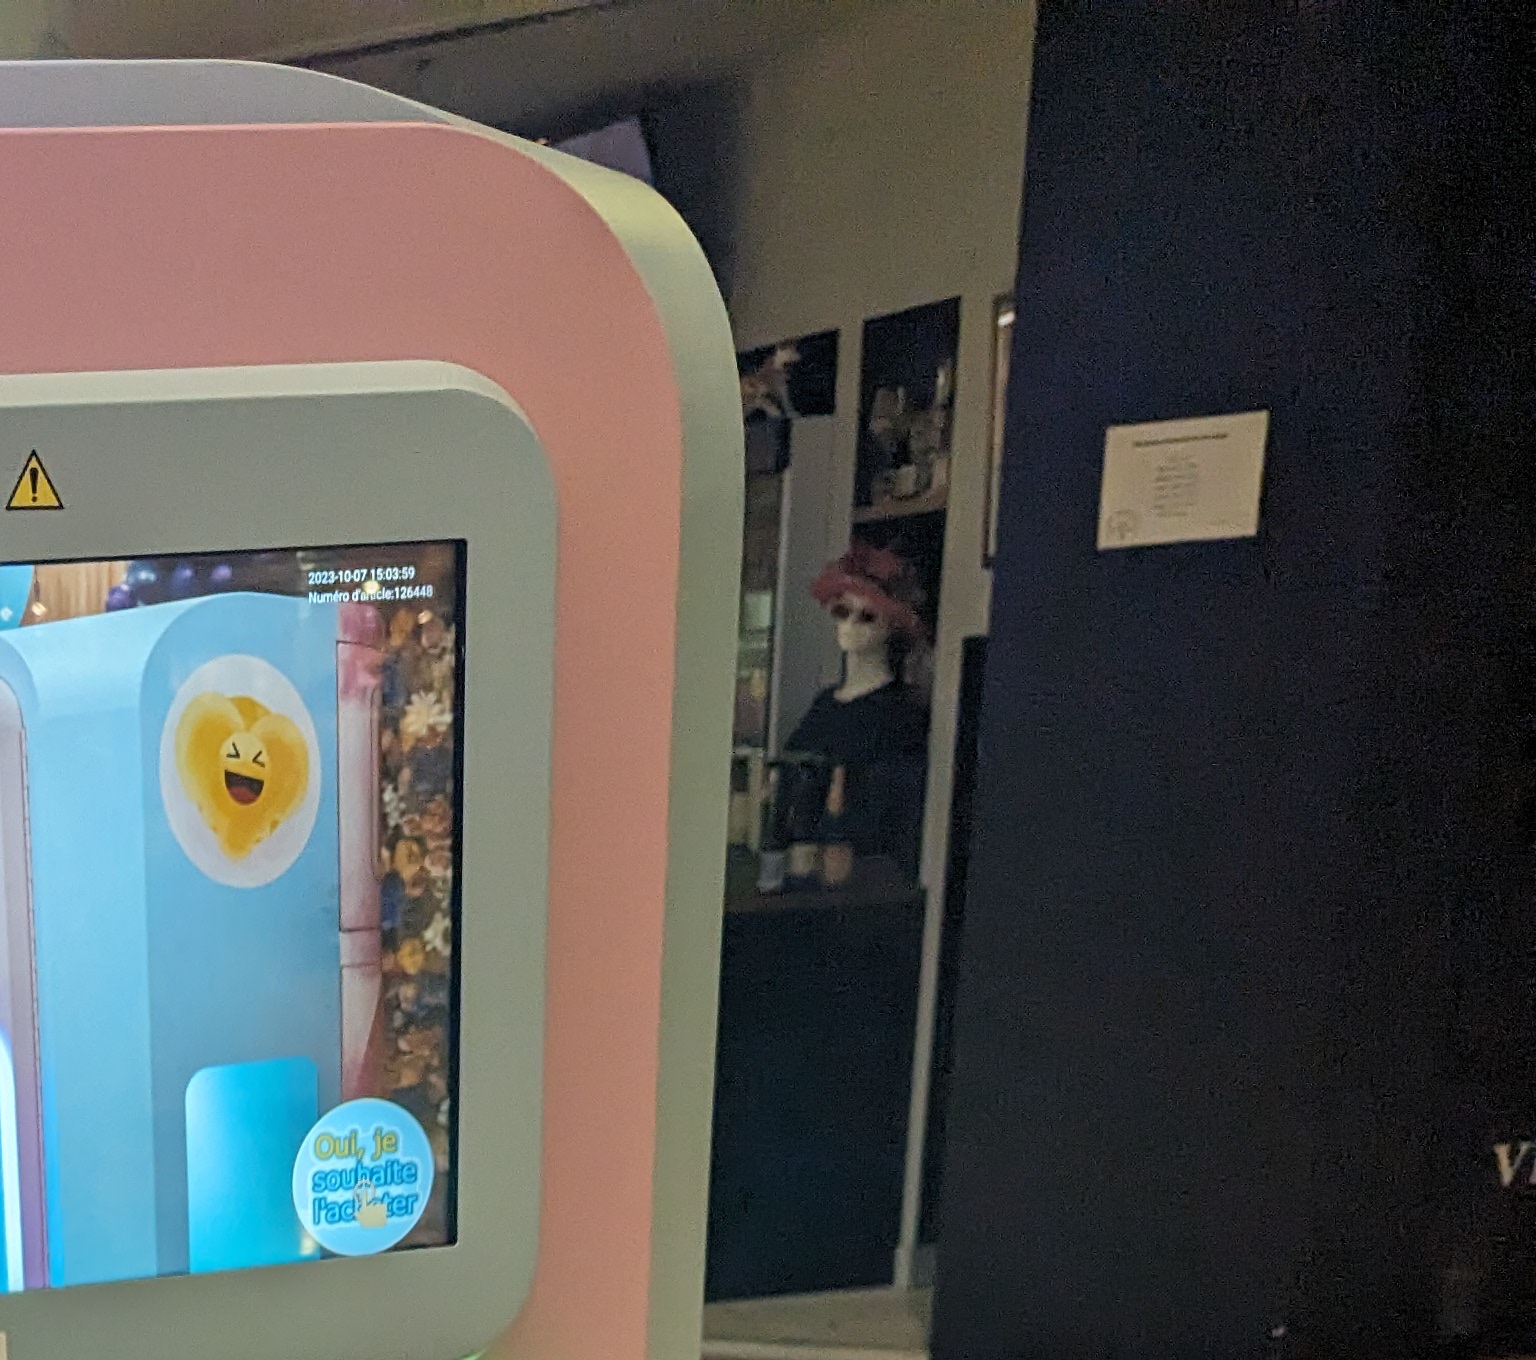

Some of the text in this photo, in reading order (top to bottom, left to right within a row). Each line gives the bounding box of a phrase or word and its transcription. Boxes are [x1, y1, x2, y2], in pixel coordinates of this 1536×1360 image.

[308, 566, 416, 585] 2023-10-07 15:03:59
[308, 588, 350, 604] Numéro
[315, 1126, 398, 1161] Oui, je
[312, 1159, 418, 1193] souhaite
[312, 1191, 420, 1226] l'acter
